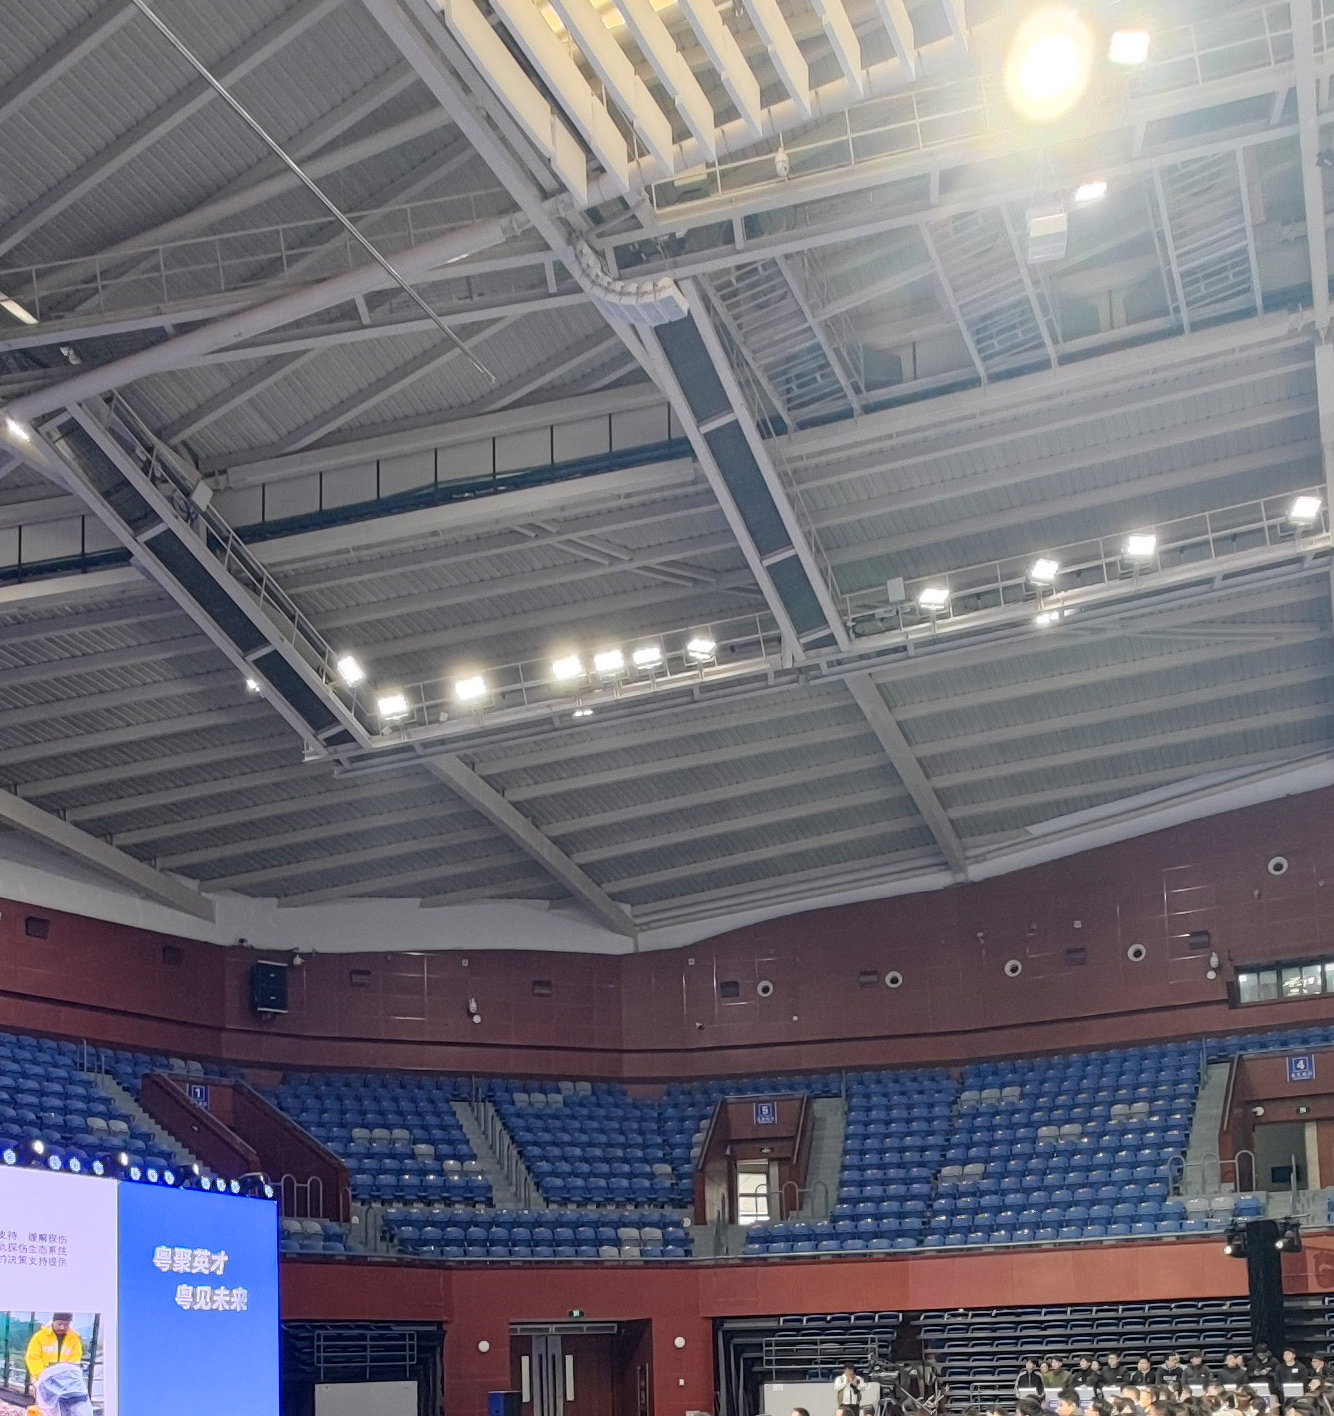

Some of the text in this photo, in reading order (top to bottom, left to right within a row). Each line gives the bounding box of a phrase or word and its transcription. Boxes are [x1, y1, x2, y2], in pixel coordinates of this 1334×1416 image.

[1296, 1059, 1306, 1070] 4
[194, 1087, 201, 1098] 1
[761, 1105, 769, 1115] 5
[153, 1244, 229, 1276] 粤聚英才
[175, 1283, 249, 1313] 粤见未来
